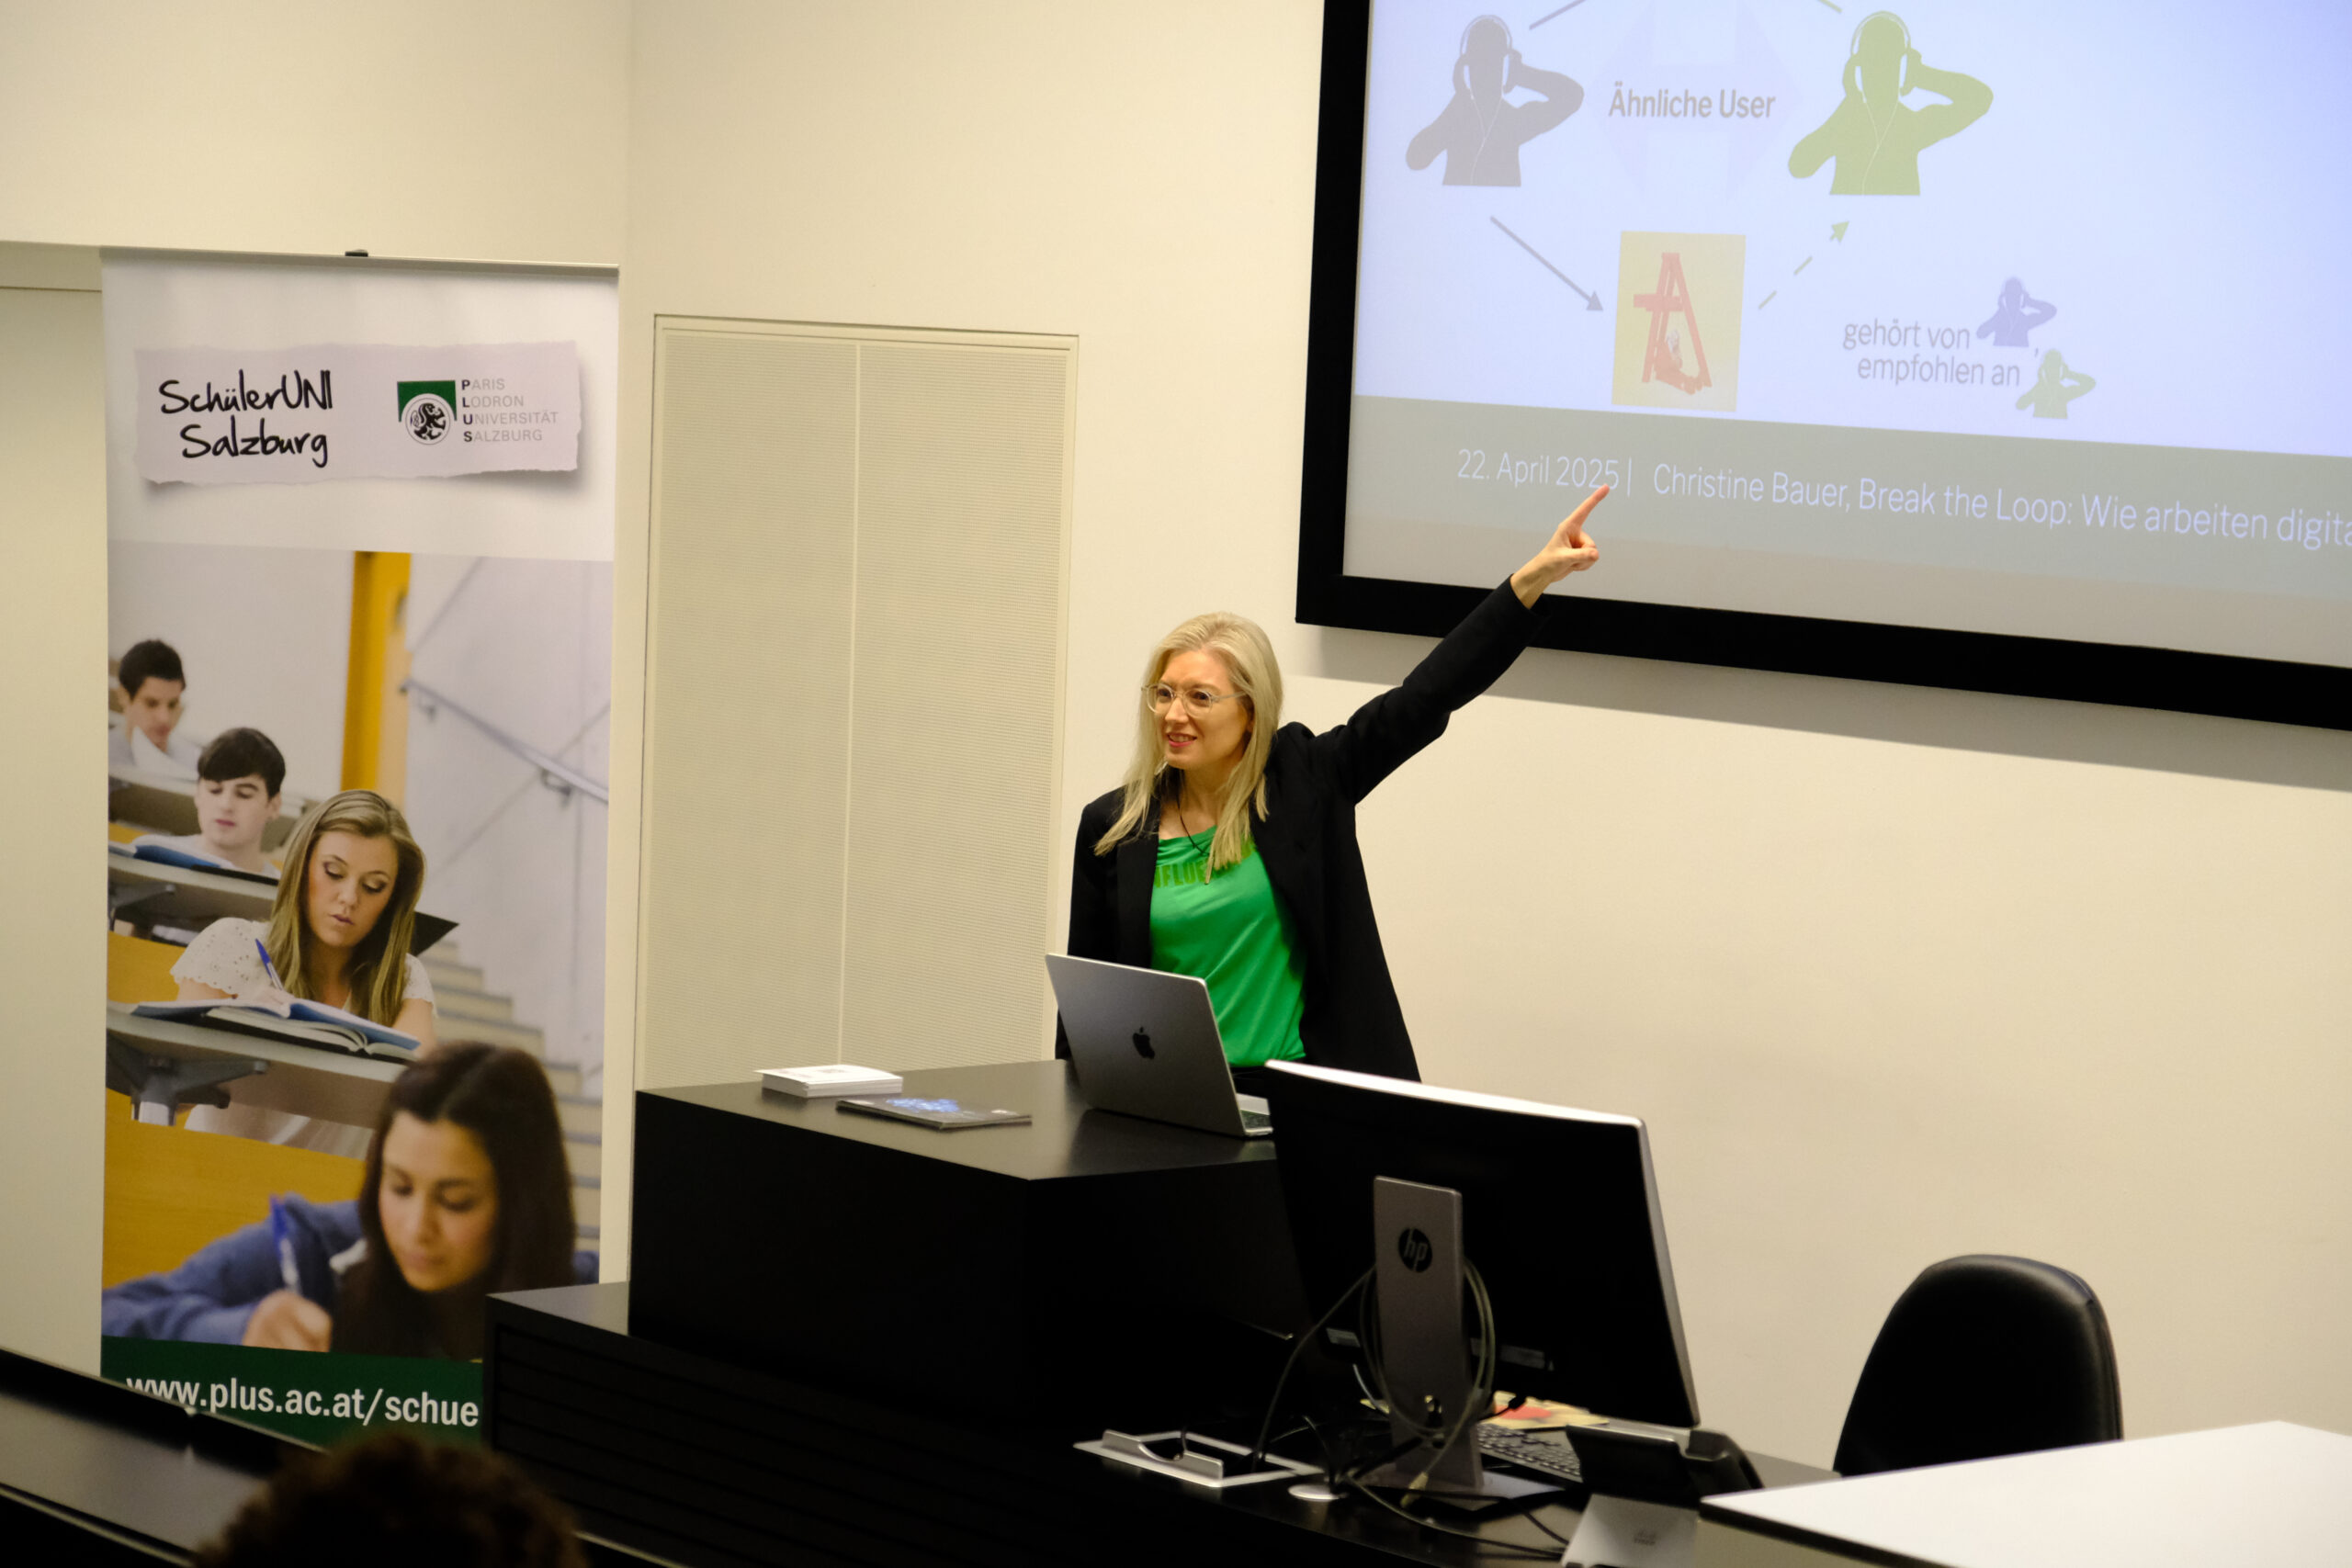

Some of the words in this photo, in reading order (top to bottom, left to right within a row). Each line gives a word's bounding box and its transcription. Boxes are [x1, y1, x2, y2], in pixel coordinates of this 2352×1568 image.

[1608, 81, 1713, 118] Ähnliche
[1719, 88, 1776, 118] User
[1842, 318, 1921, 351] gehört
[1928, 327, 1970, 350] von
[461, 378, 505, 390] PARIS
[1858, 354, 1984, 386] empfohlen
[1991, 364, 2020, 387] an
[158, 368, 334, 414] SchülerUNI
[462, 395, 524, 408] LODRON
[463, 410, 559, 425] UNIVERSITÄT
[180, 415, 328, 468] Salzburg
[463, 429, 543, 443] SALZBURG
[1458, 448, 1489, 479] 22.
[1497, 452, 1549, 488] April
[1555, 456, 1619, 490] 2025
[1654, 464, 1764, 502] Christine
[1772, 471, 1850, 513] Bauer,
[1860, 478, 1935, 514] Break
[1943, 485, 1987, 518] the
[1996, 489, 2072, 529] Loop:
[2082, 494, 2137, 530] Wie
[2144, 501, 2267, 539] arbeiten
